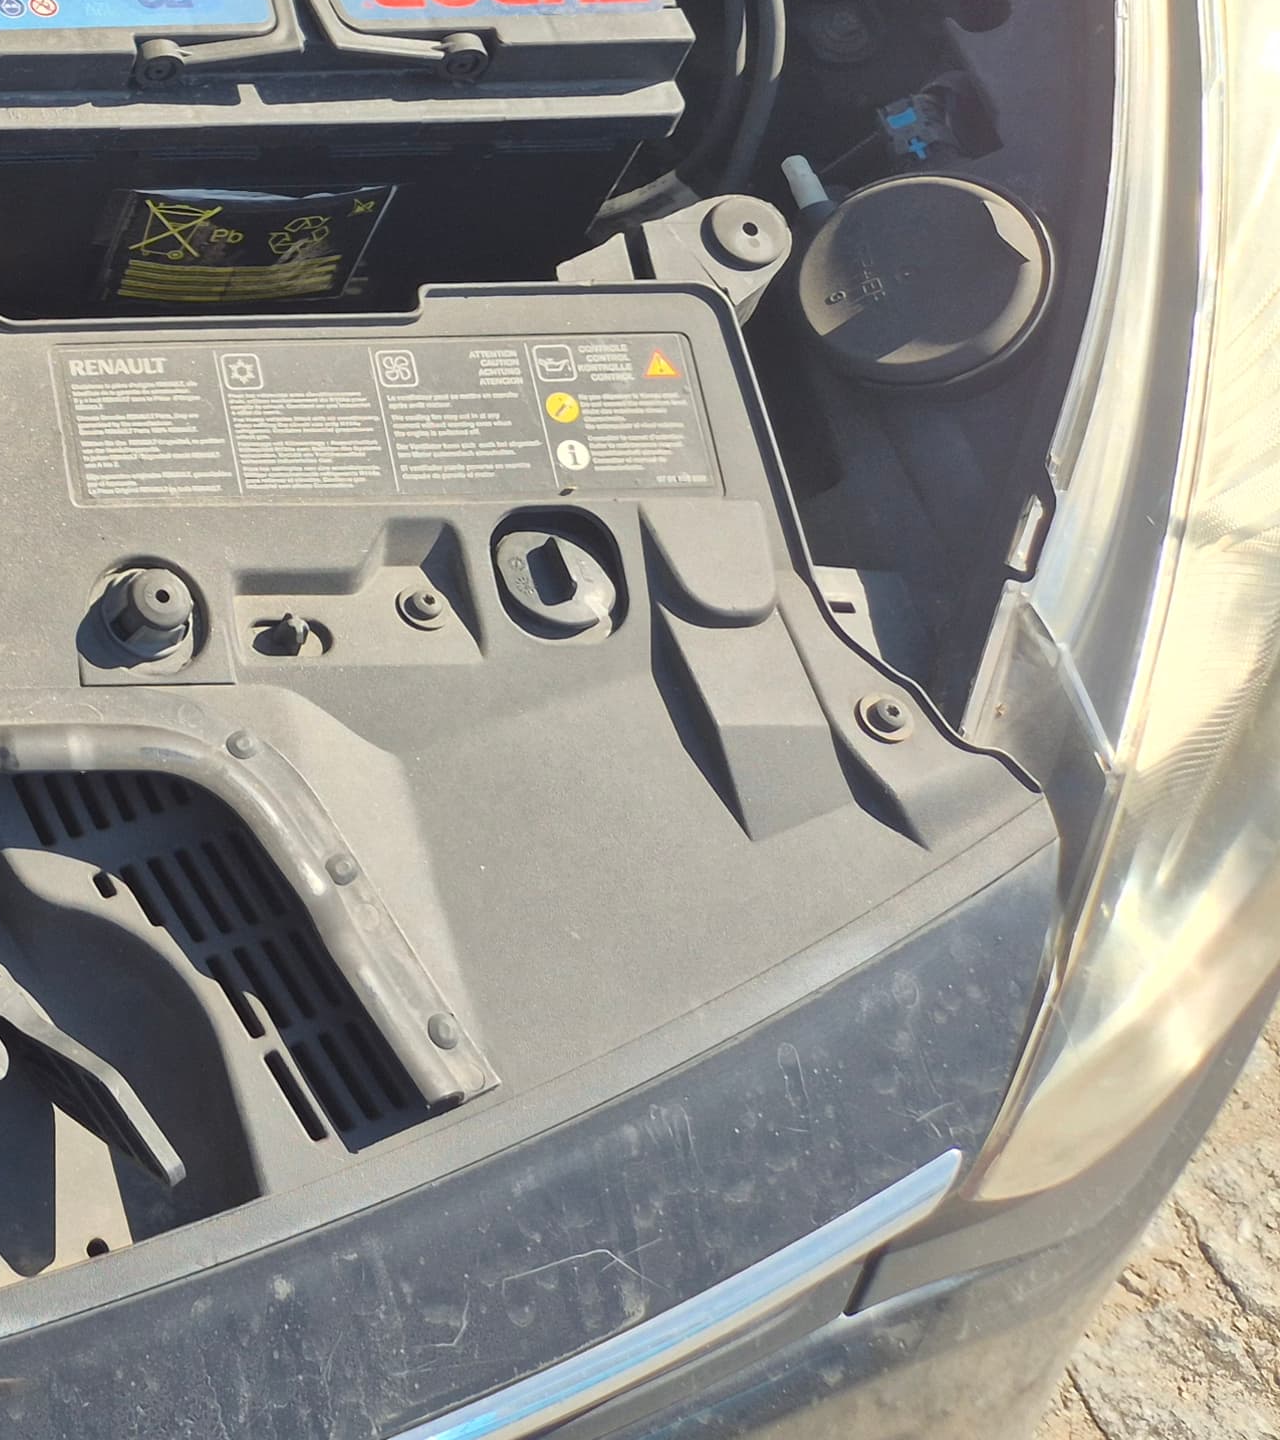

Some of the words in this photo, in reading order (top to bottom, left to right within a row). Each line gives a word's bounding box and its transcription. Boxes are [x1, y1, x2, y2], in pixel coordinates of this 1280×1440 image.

[209, 228, 245, 245] Pb
[469, 350, 517, 359] ATTENTION
[69, 357, 168, 376] RENAULT
[480, 359, 519, 367] CAUTION
